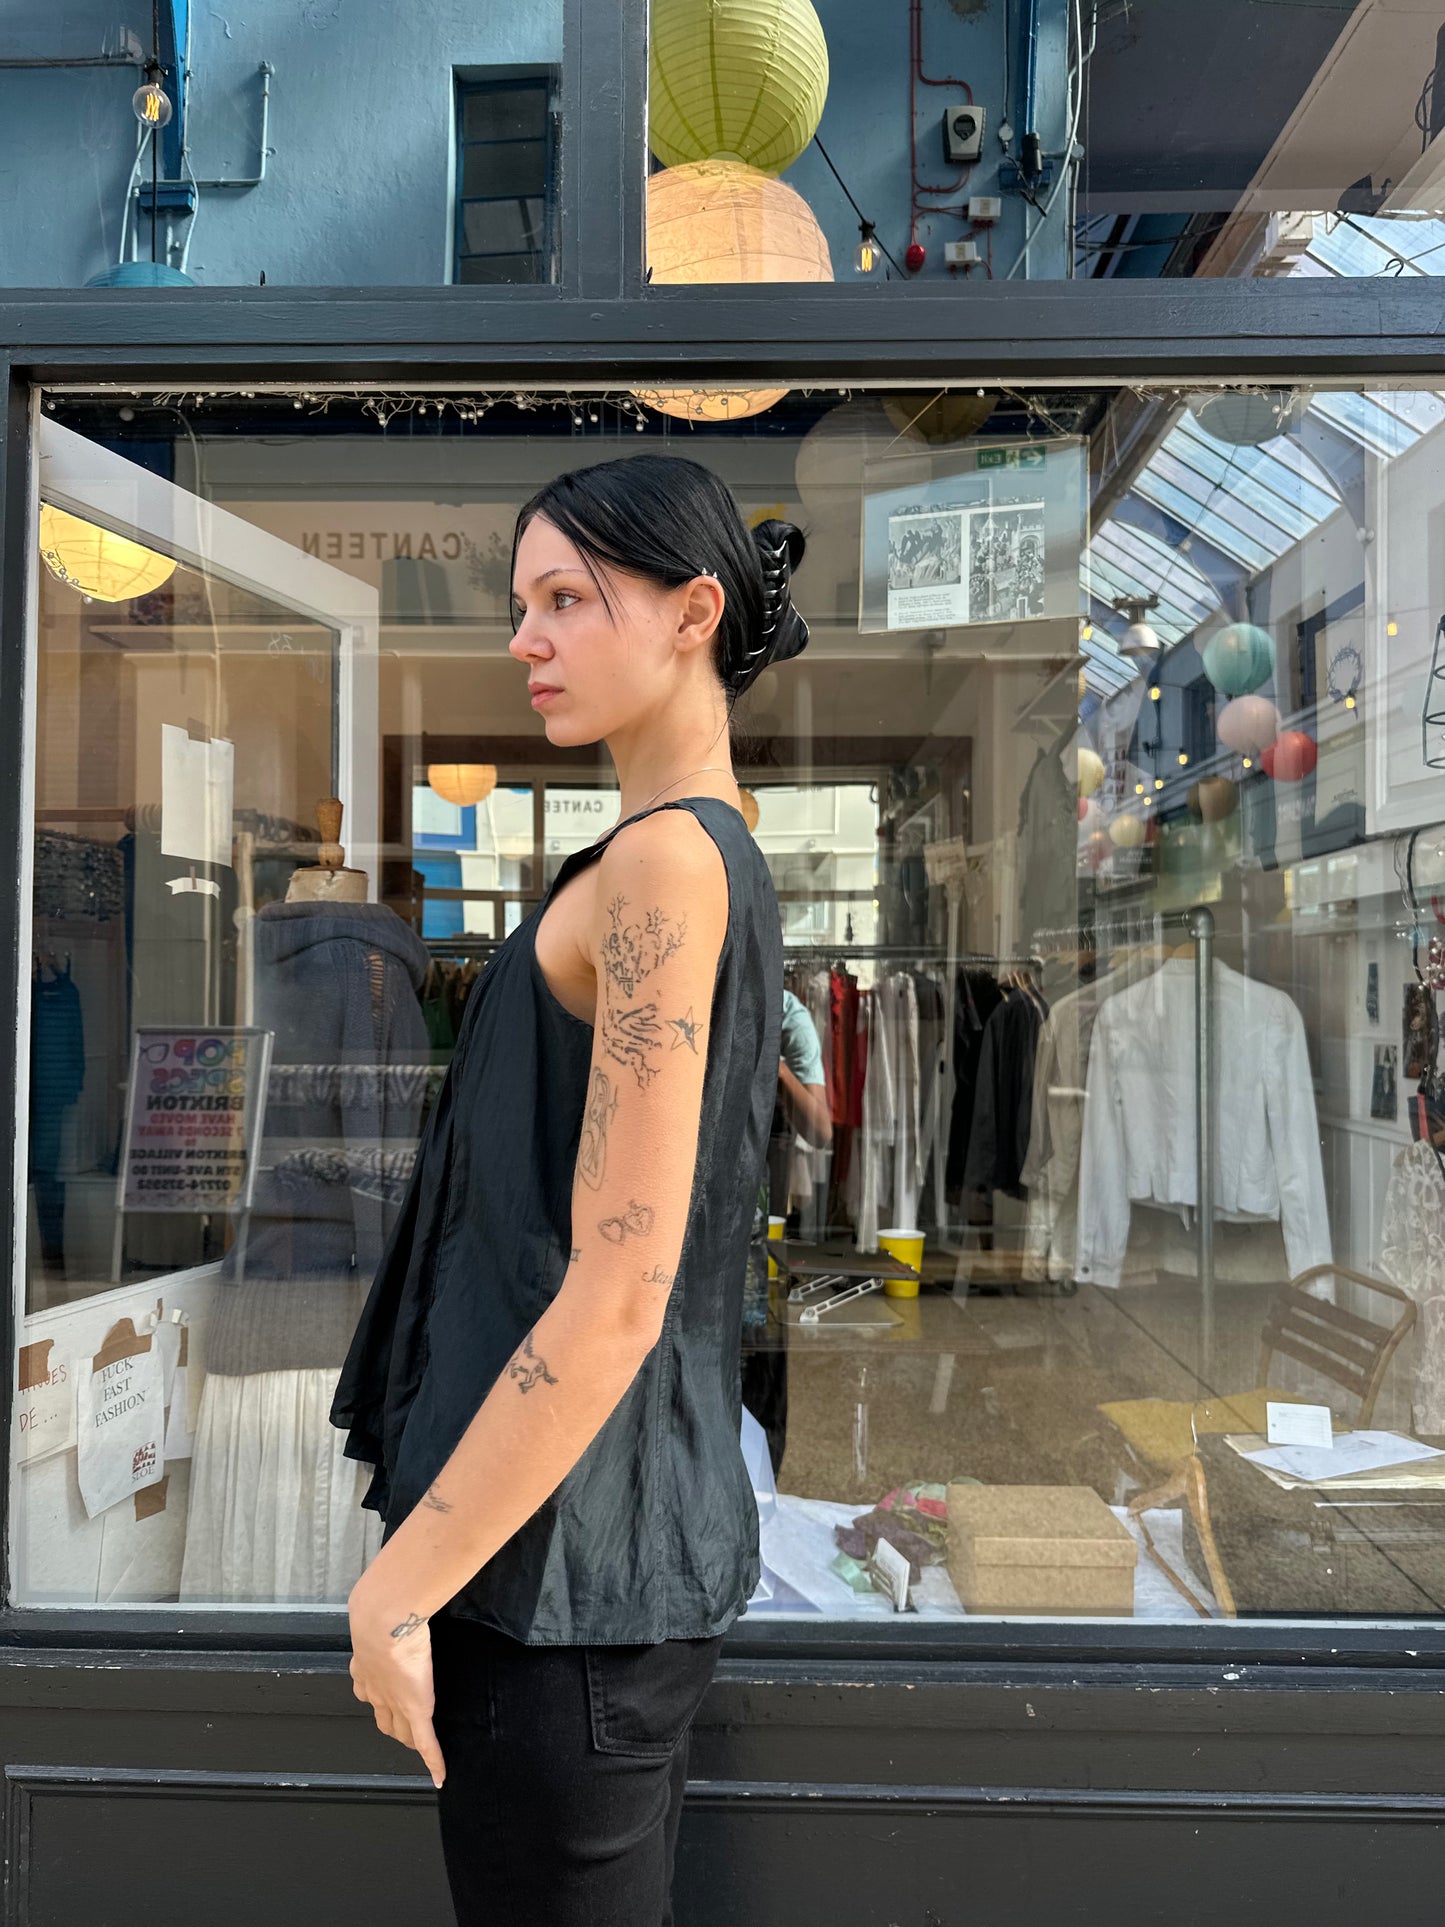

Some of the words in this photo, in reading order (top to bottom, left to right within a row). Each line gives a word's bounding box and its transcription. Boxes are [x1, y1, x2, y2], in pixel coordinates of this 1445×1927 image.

[102, 1357, 134, 1383] FUCK
[103, 1376, 132, 1402] FAST
[94, 1387, 148, 1428] FASHION
